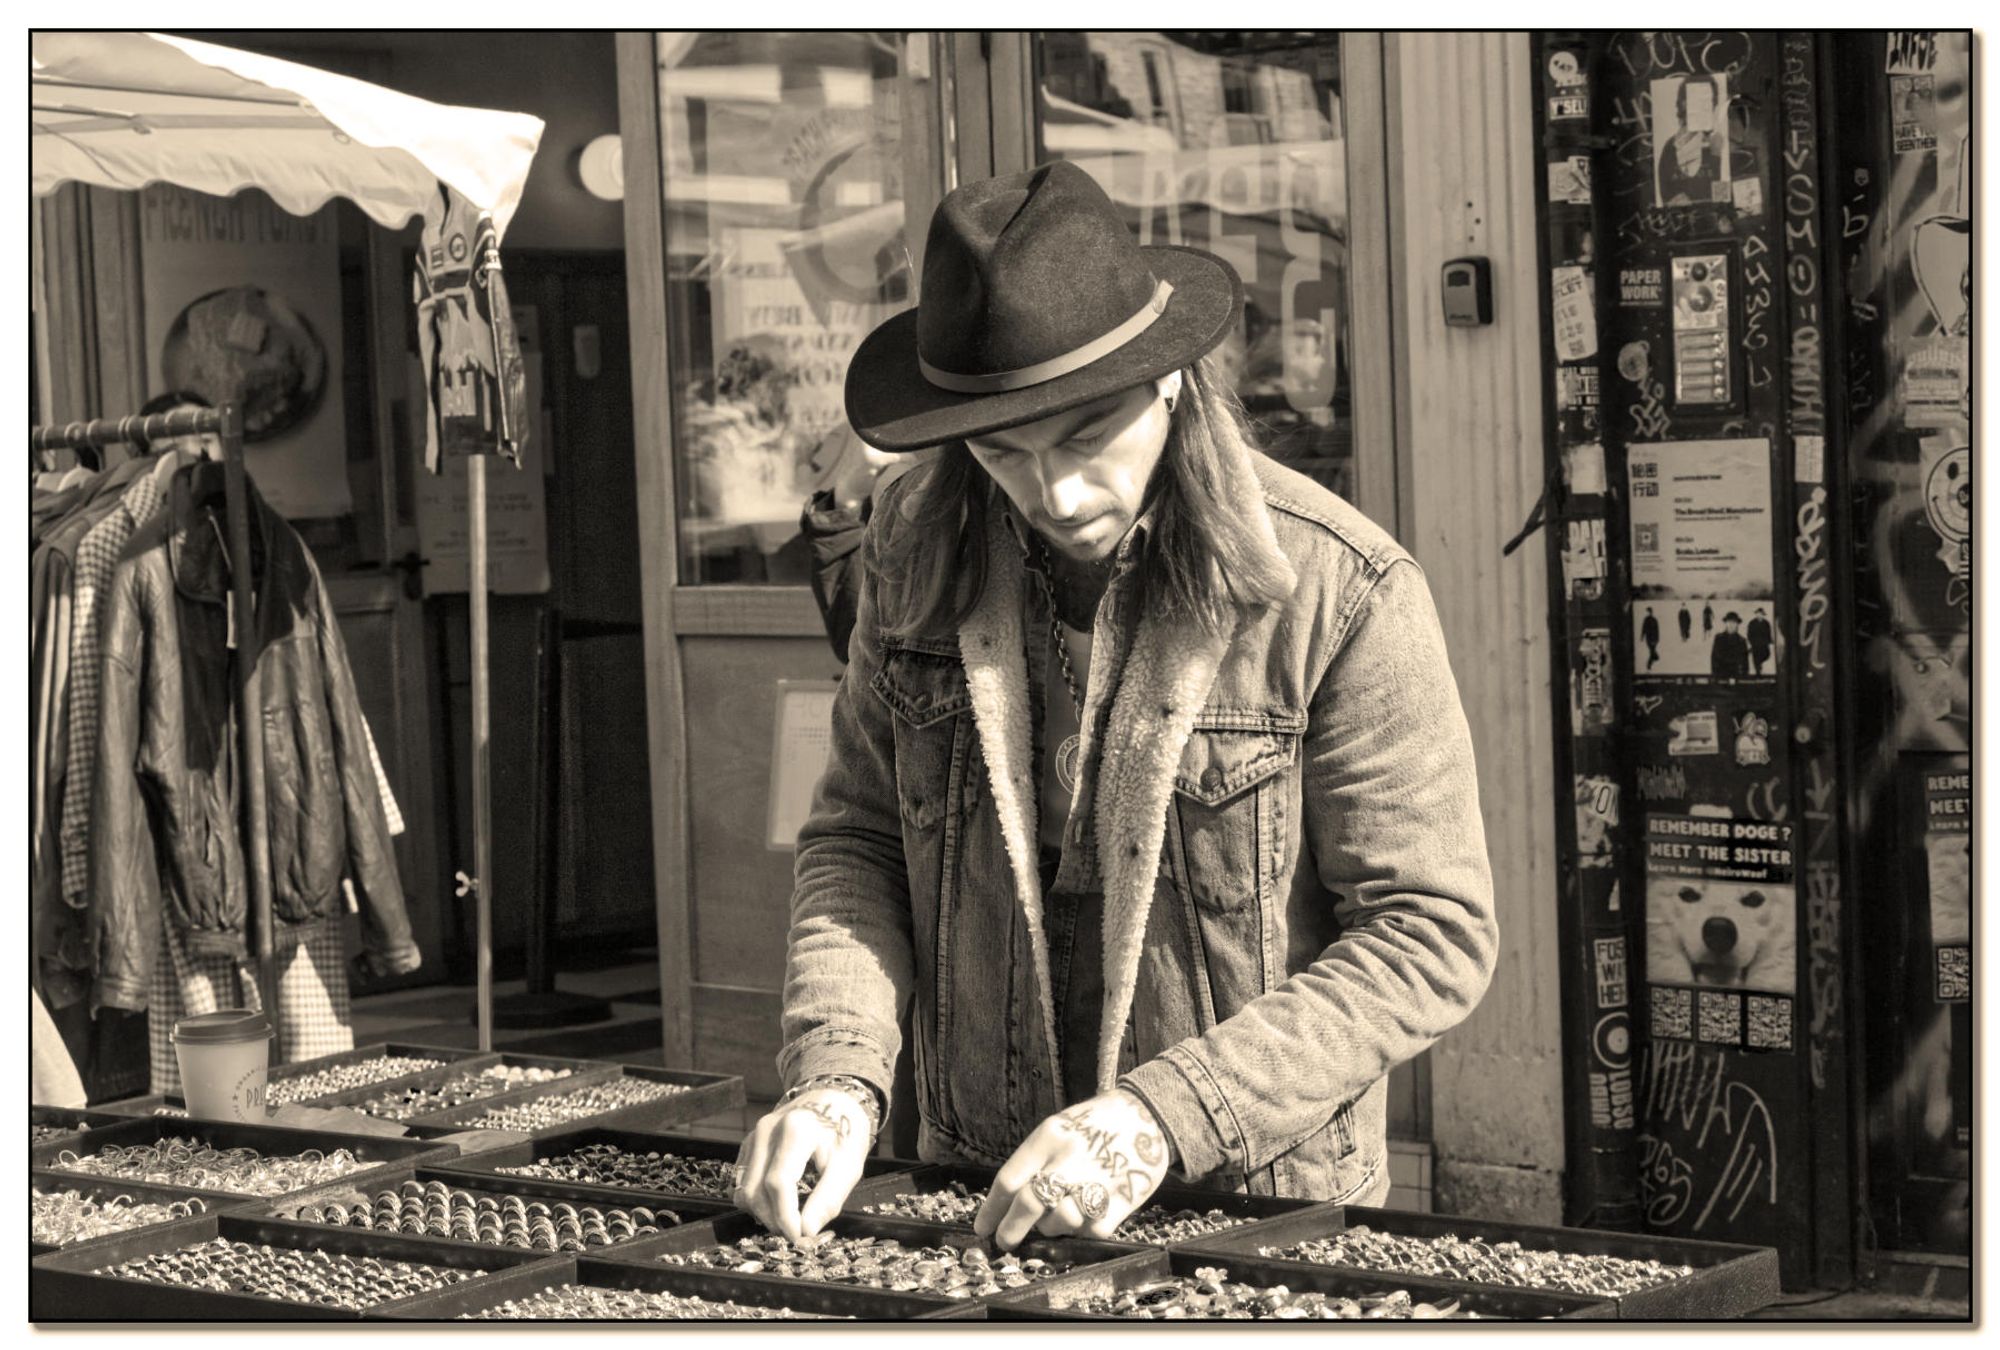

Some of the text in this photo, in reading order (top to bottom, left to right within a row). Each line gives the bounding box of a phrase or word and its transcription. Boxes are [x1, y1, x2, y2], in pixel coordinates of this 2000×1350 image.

[1620, 269, 1662, 285] PAPER
[1649, 819, 1792, 841] REMEMBER DOGE ?
[1650, 842, 1792, 865] MEET THE SISTER
[1647, 863, 1677, 873] Learn
[1678, 865, 1704, 875] More
